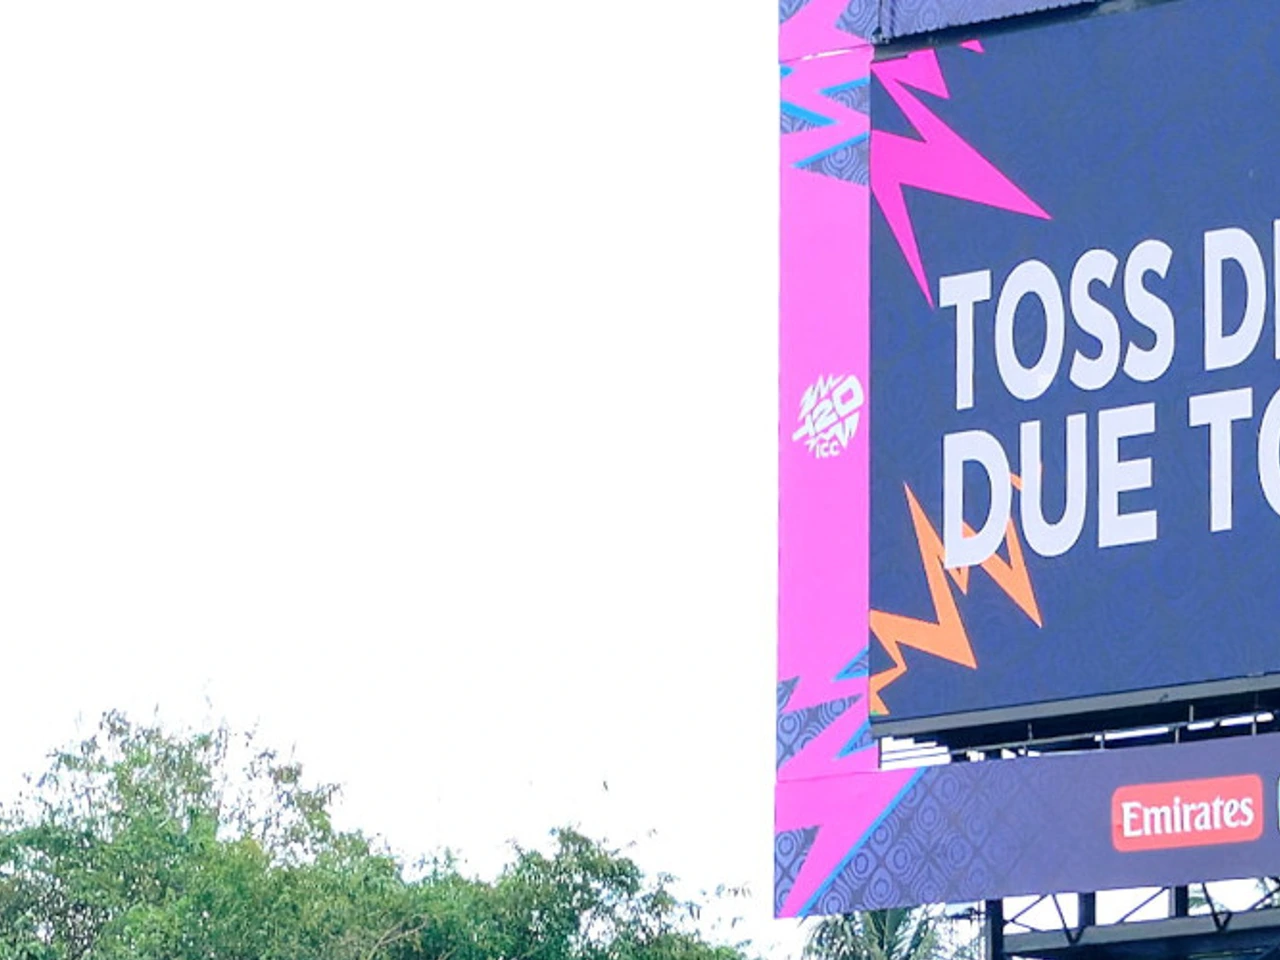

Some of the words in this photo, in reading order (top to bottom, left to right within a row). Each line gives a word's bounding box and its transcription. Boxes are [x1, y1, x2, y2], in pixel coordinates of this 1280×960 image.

[939, 239, 1176, 410] TOSS
[816, 441, 840, 458] ICC
[943, 402, 1158, 569] DUE
[1120, 796, 1254, 837] Emirates
